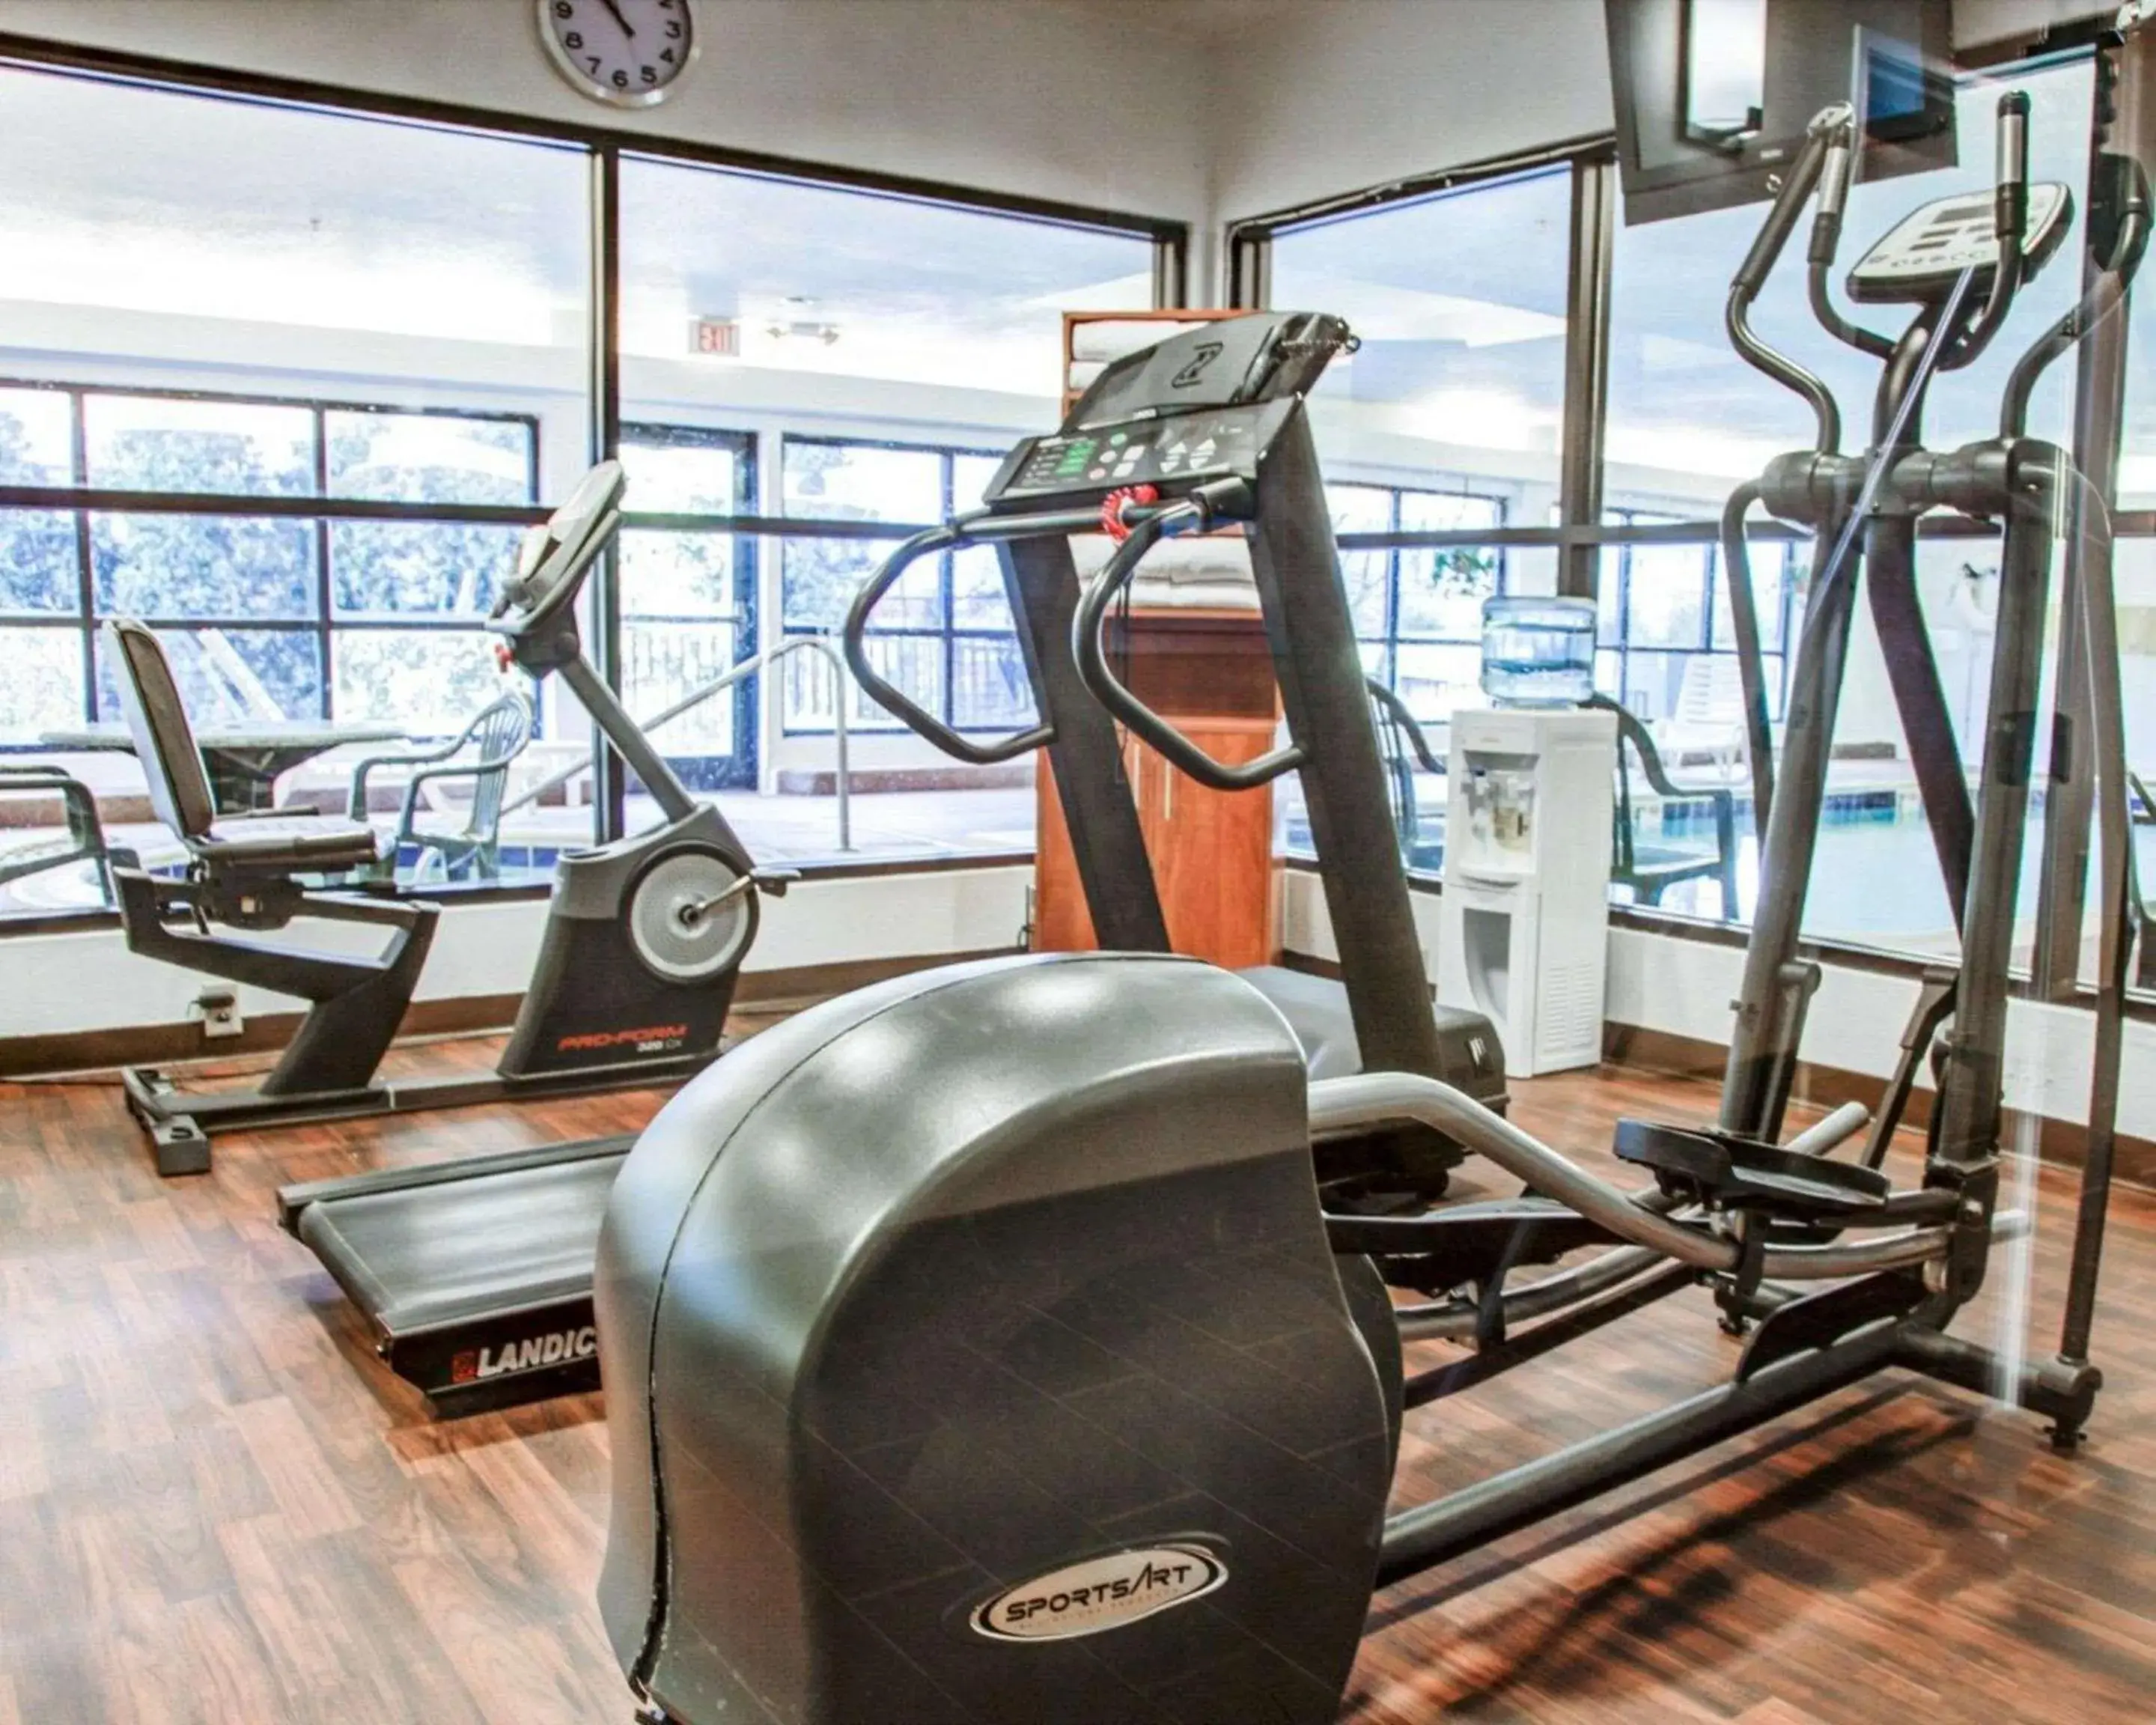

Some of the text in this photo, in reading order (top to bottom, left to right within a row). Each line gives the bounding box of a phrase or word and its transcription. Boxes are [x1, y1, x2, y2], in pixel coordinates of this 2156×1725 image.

[557, 0, 573, 19] 9
[666, 20, 680, 38] 3
[565, 31, 582, 49] 8
[660, 48, 673, 63] 4
[586, 57, 601, 74] 7
[641, 65, 657, 83] 5
[612, 70, 628, 88] 6
[558, 1024, 687, 1050] PRO-FORM
[1006, 1562, 1191, 1622] SPORTSART
